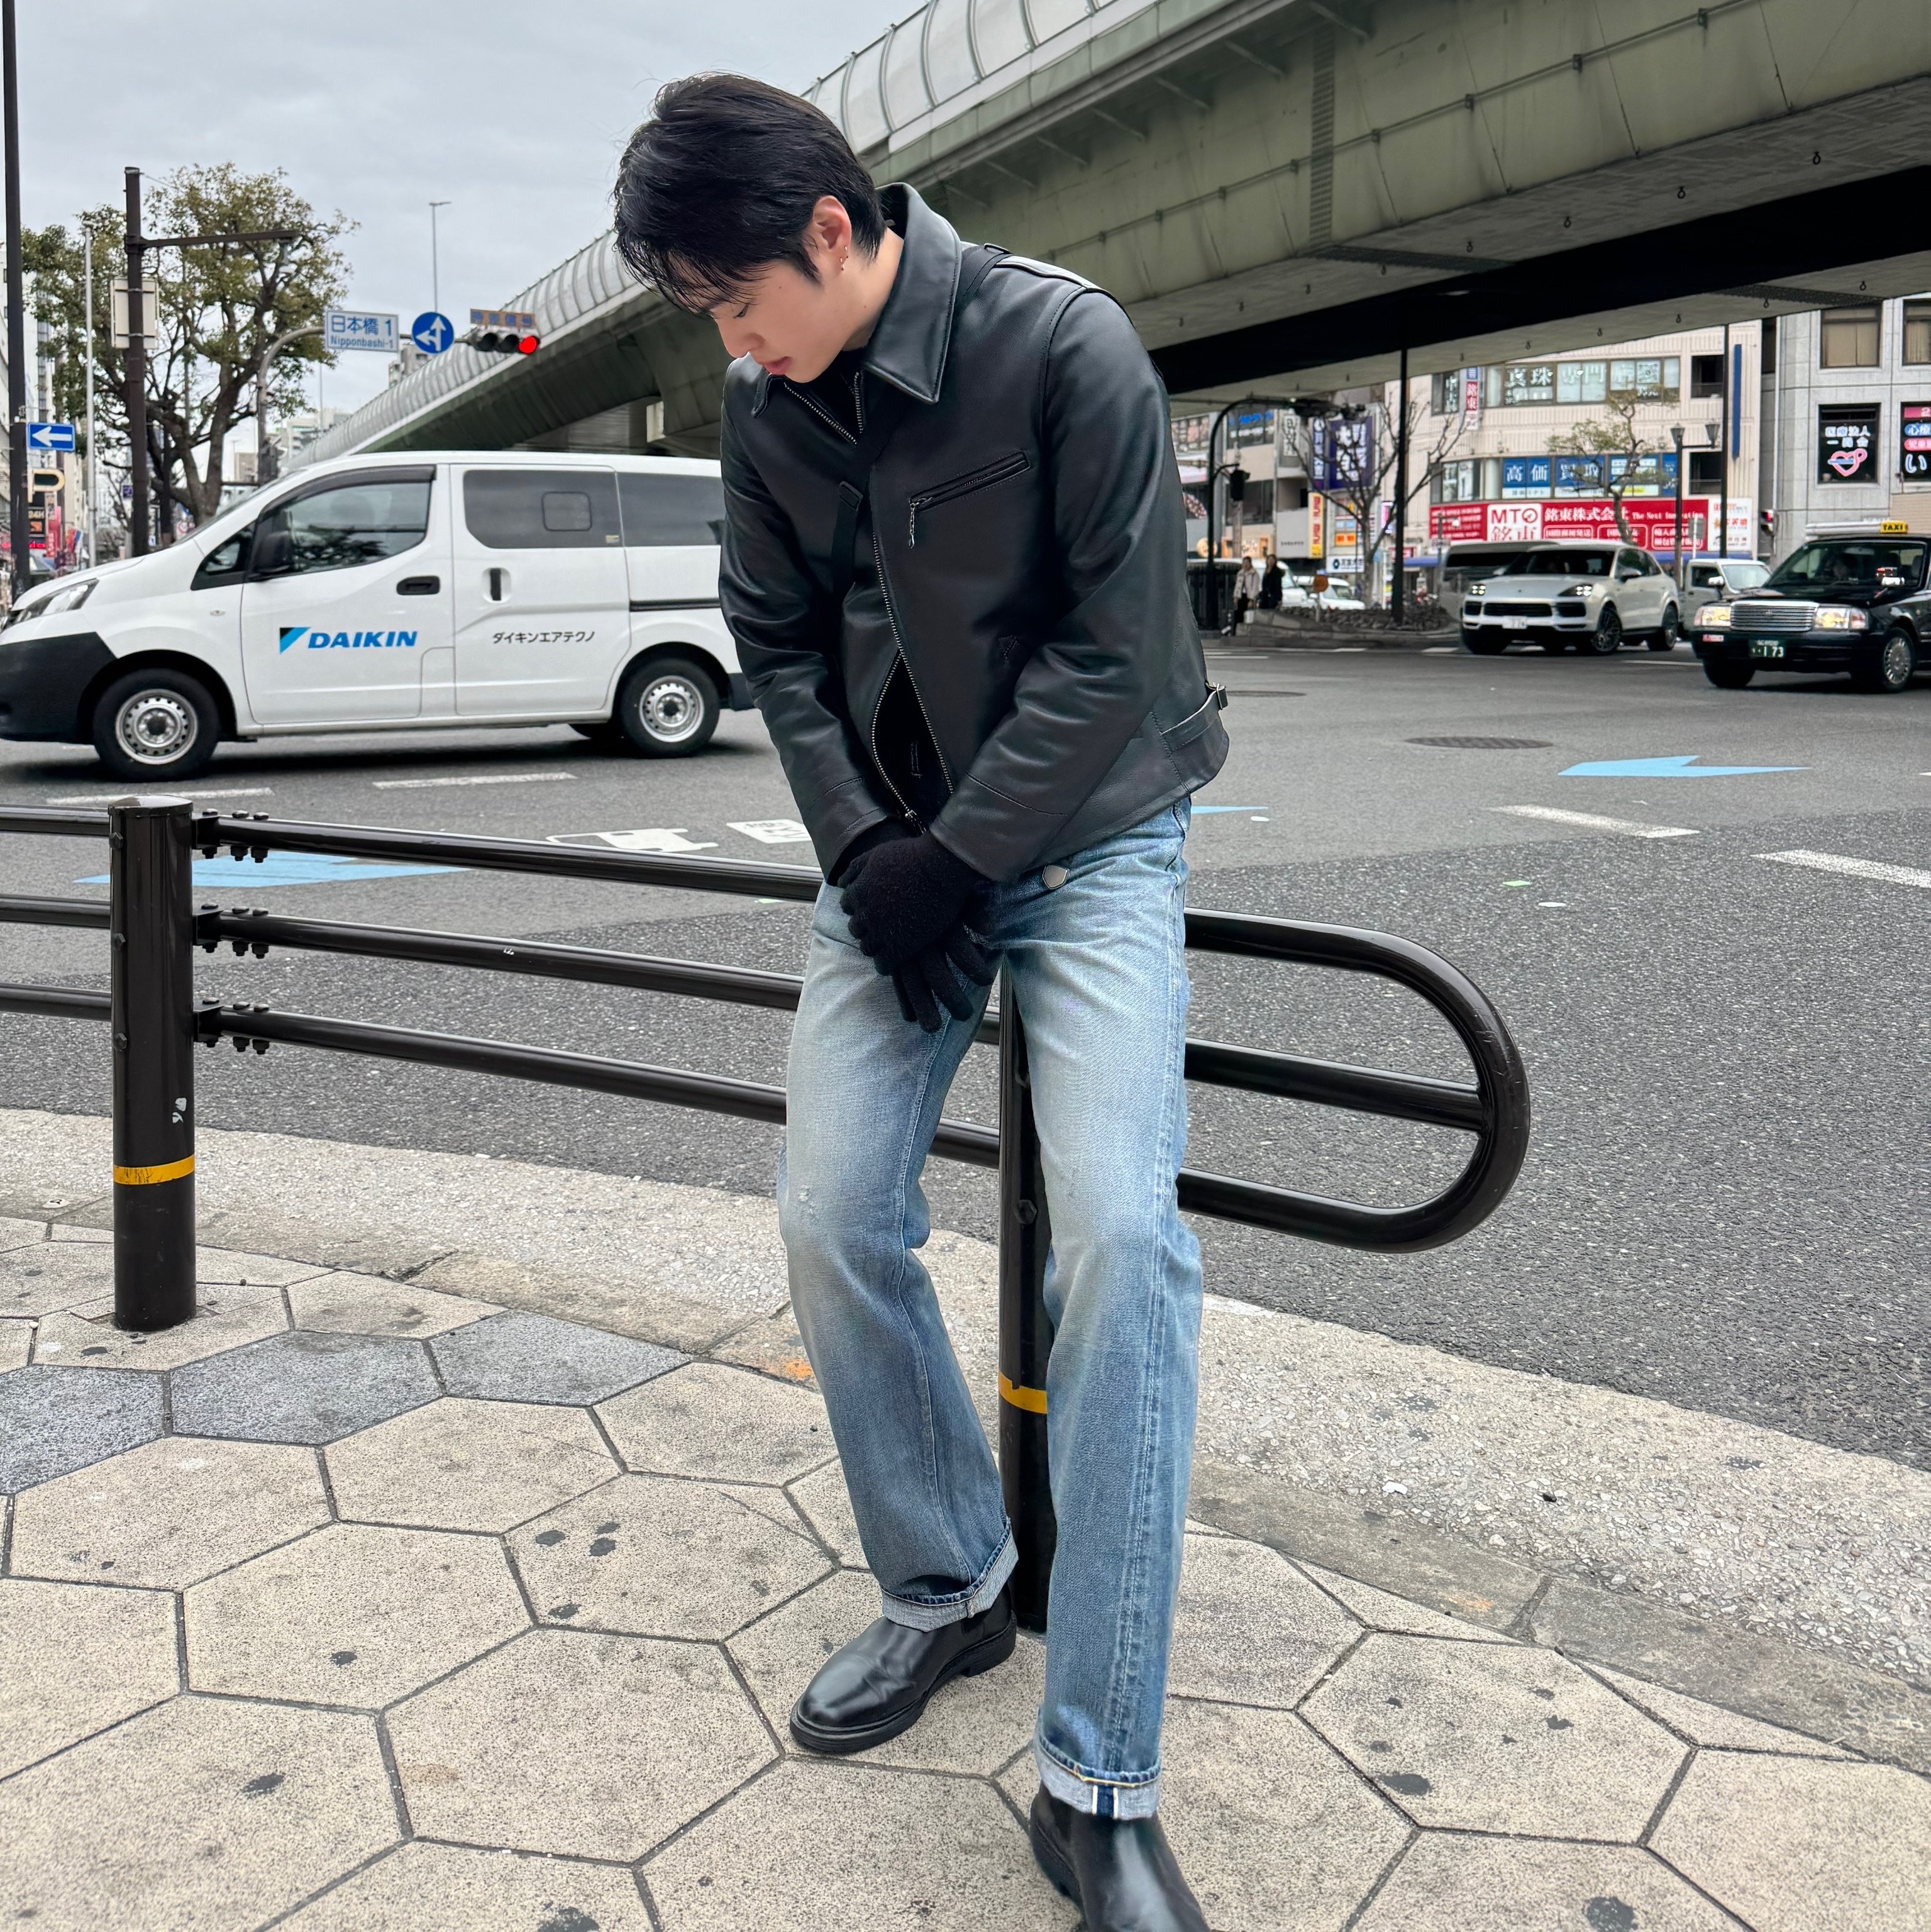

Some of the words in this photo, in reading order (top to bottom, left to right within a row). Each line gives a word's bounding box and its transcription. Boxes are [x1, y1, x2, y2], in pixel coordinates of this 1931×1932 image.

[331, 315, 380, 335] 日本橋
[385, 319, 392, 336] 1
[331, 336, 394, 350] Nipponbashi-1
[1632, 511, 1644, 520] The
[1646, 511, 1662, 520] Next
[1665, 510, 1704, 520] Innation
[307, 631, 418, 649] DAIKIN
[492, 631, 595, 645] ダイキンエアテクノ
